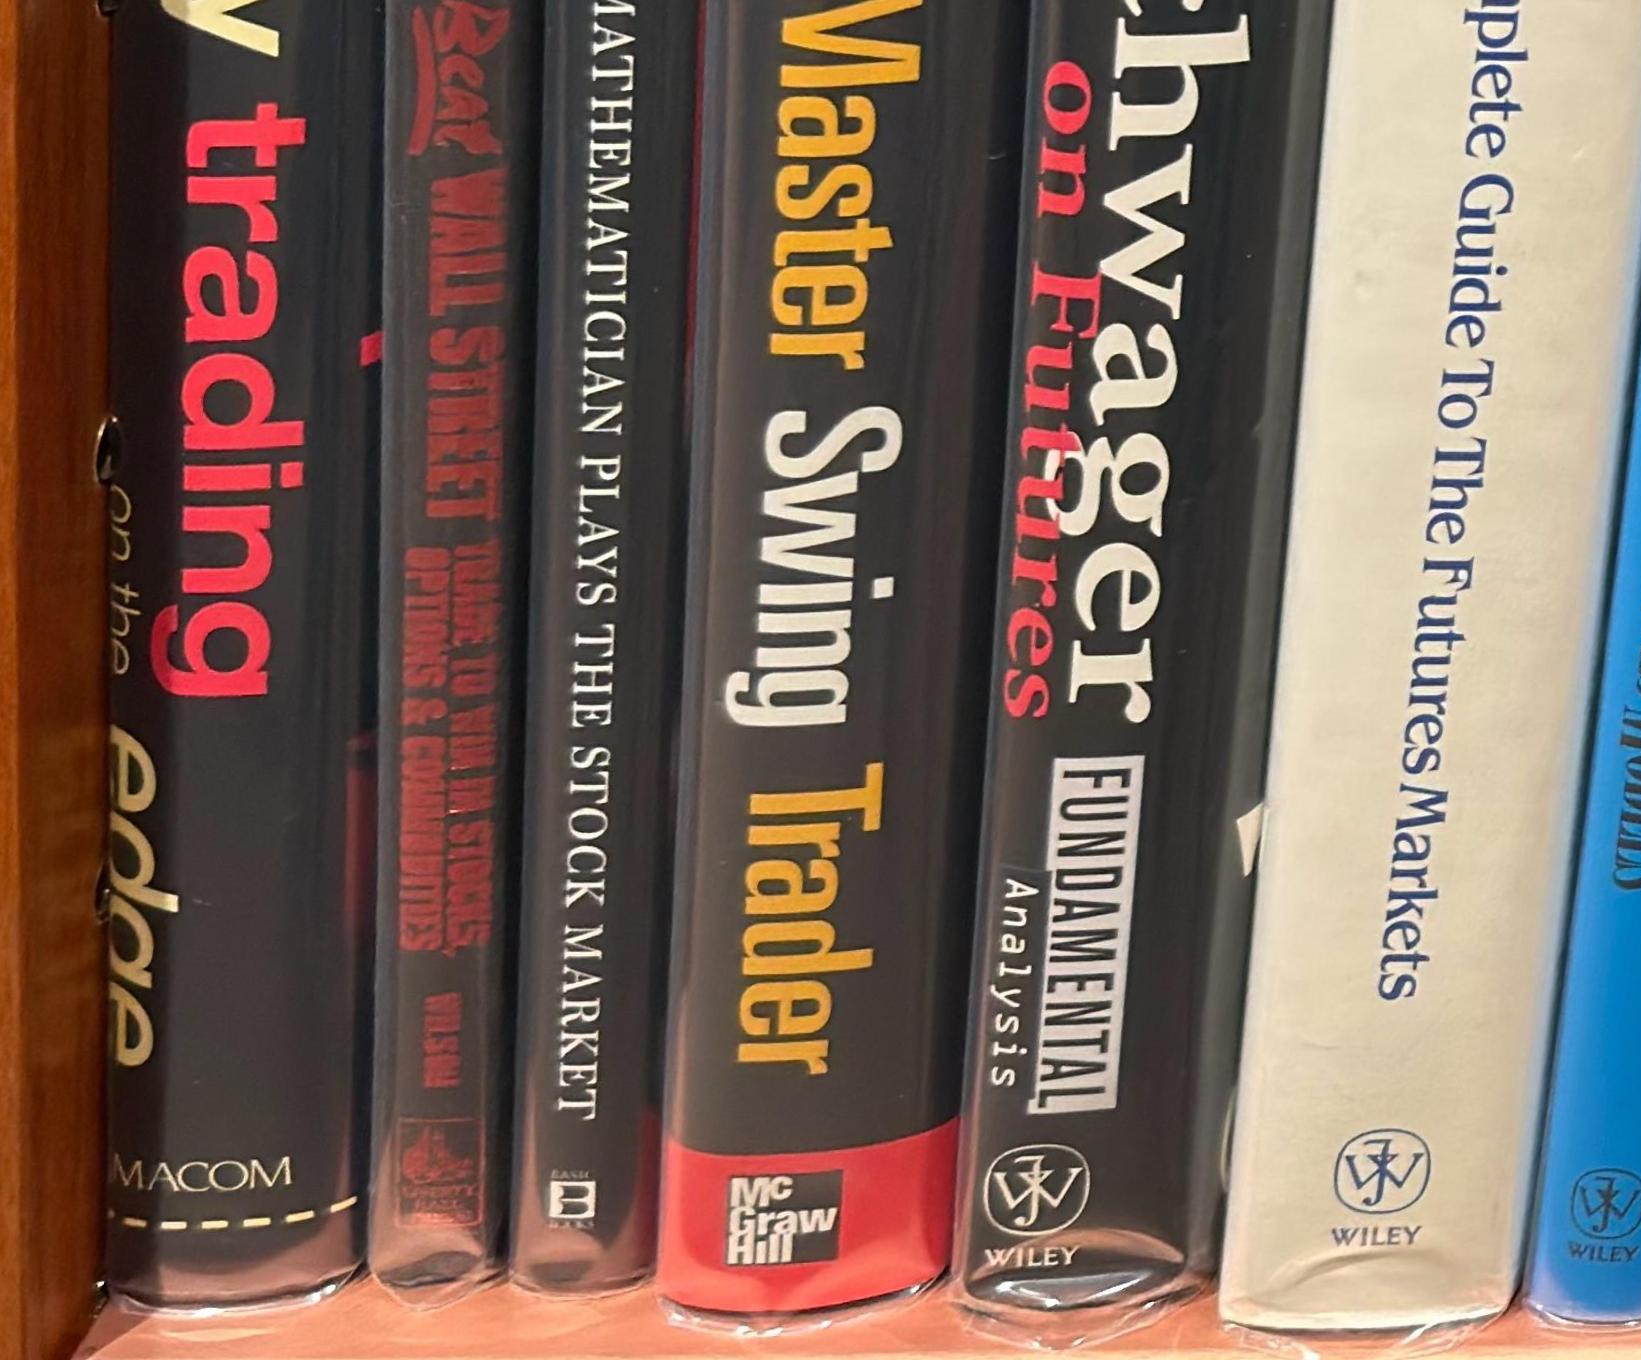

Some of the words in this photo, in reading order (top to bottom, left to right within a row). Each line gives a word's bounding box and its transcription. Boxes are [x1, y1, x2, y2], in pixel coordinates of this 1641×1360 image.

[1037, 60, 1093, 216] on
[427, 167, 509, 316] WALL
[1443, 171, 1514, 348] Guide
[150, 103, 307, 699] trading
[426, 325, 508, 522] STREET
[1429, 358, 1493, 430] To
[575, 454, 622, 607] PLAYS
[727, 406, 903, 727] Swing
[1004, 262, 1102, 721] Futures
[1425, 436, 1486, 544] The
[570, 624, 616, 729] THE
[1401, 557, 1473, 775] Futures
[566, 744, 614, 908] STOCK
[1377, 784, 1449, 1001] Markets
[737, 762, 884, 1077] Trader
[988, 878, 1041, 1088] Analysis
[1036, 767, 1134, 1108] FUNDAMENTAL
[555, 924, 606, 1121] MARKET
[727, 1201, 839, 1237] Graw
[985, 1242, 1076, 1270] WILEY
[1331, 1224, 1421, 1247] WILEY
[1568, 1242, 1638, 1263] WILEY
